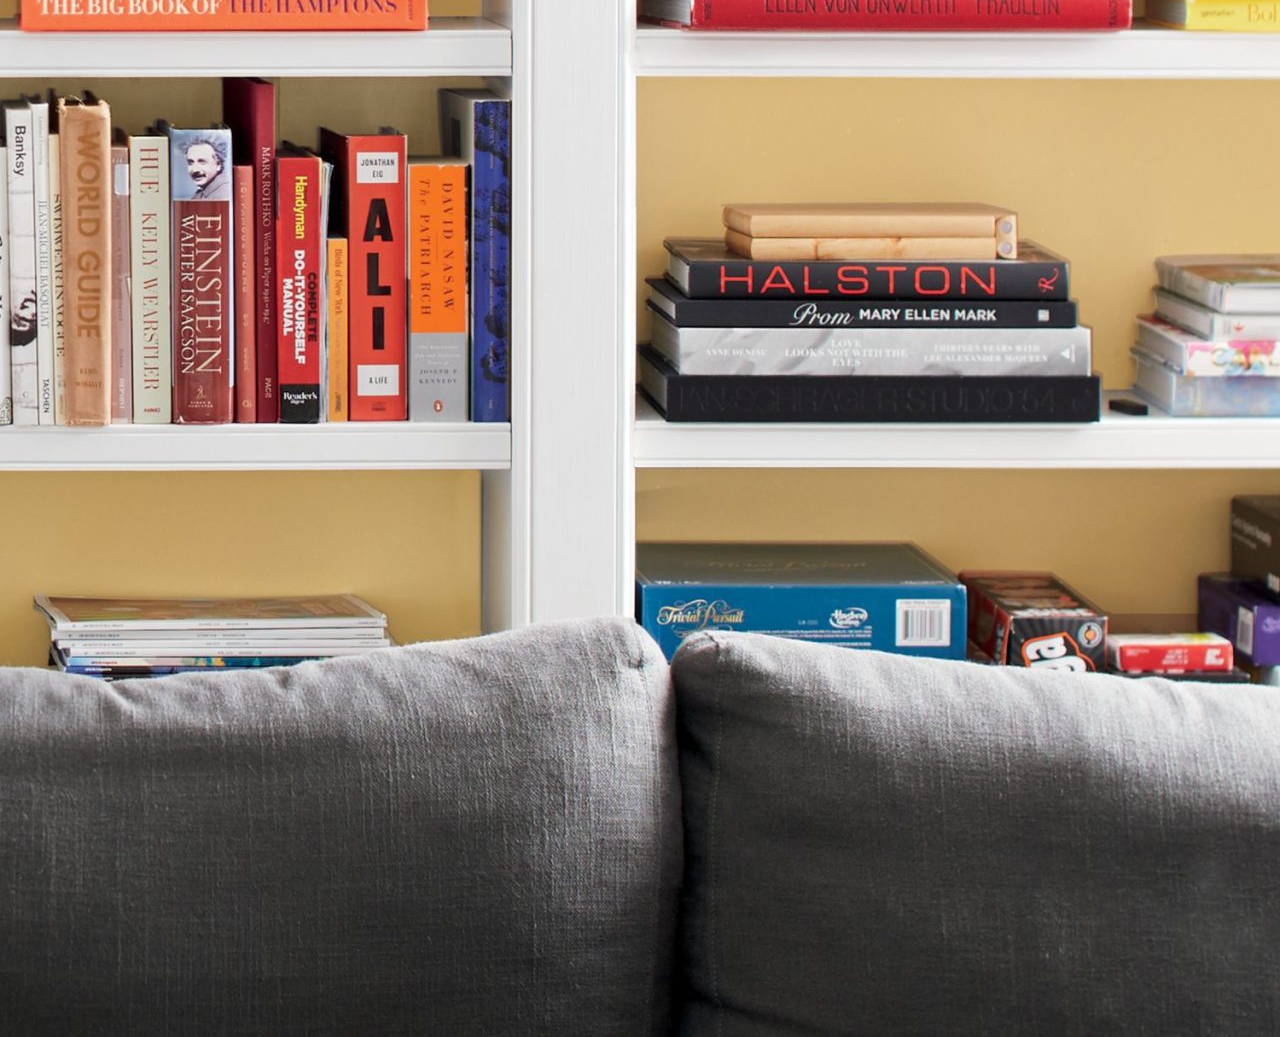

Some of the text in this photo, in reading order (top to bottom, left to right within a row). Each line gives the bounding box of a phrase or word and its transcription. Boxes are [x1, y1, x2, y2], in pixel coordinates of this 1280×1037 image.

[13, 125, 27, 177] Banksy
[360, 159, 395, 167] JONATHAN
[293, 176, 308, 239] Handyman
[76, 131, 101, 338] WORLD GUIDE
[180, 215, 195, 374] WALTER ISAACSON
[195, 214, 222, 374] EINSTEIN
[719, 265, 996, 295] HALSTON
[282, 278, 294, 336] MANUAL
[788, 302, 997, 326] Prom MARY ELLEN MARK
[784, 349, 909, 358] LOOKS NOT WITH THE
[831, 339, 862, 348] LOVE
[831, 358, 861, 367] EYES
[42, 379, 50, 413] TASCHEN
[656, 600, 745, 628] Trivial Pursuit
